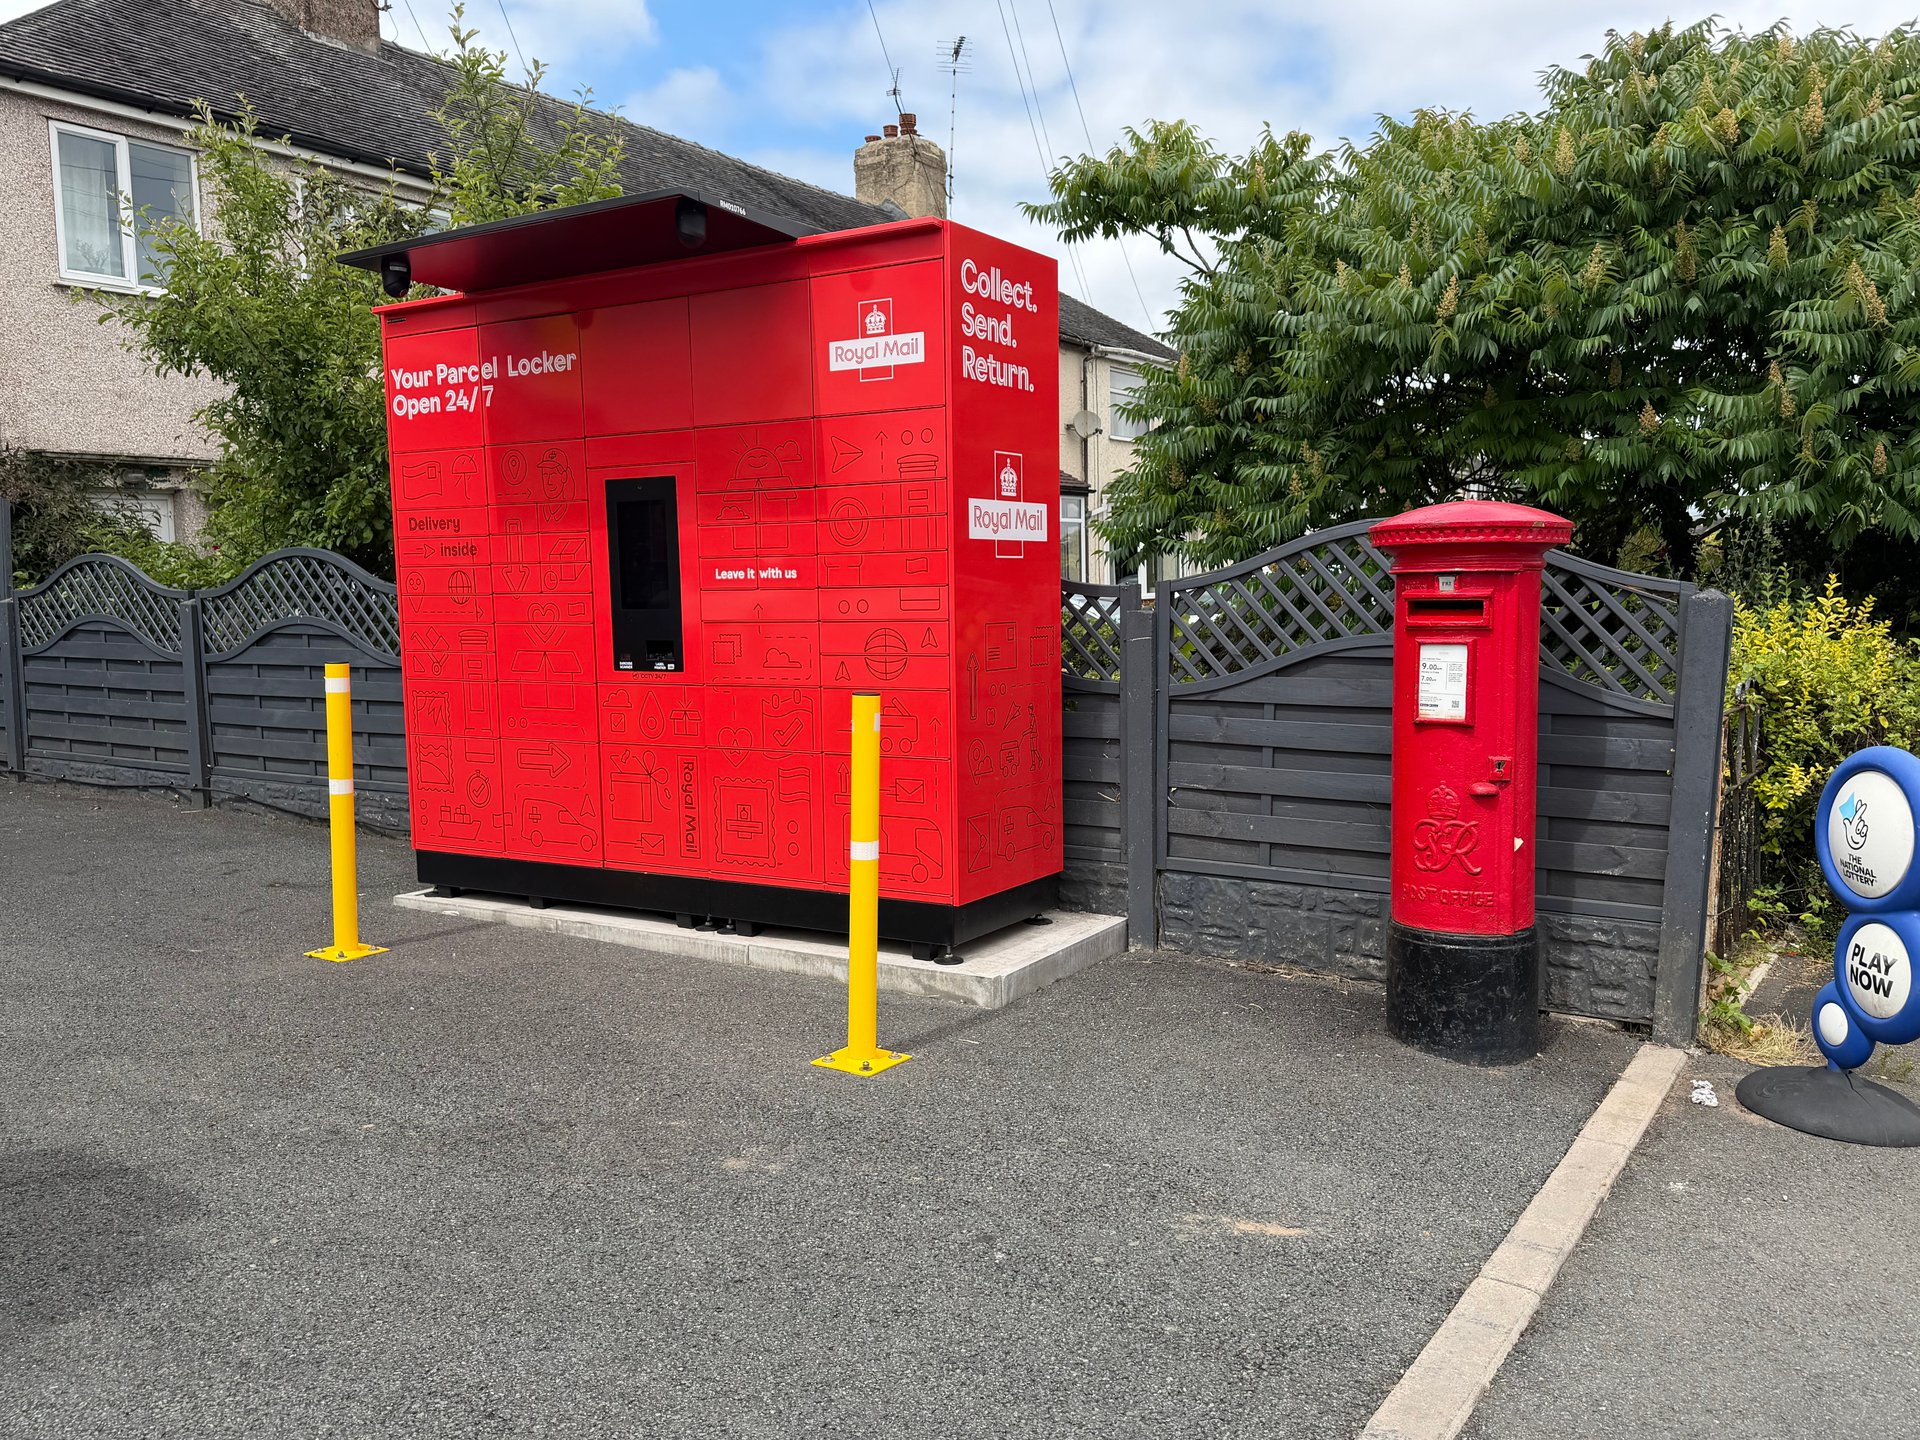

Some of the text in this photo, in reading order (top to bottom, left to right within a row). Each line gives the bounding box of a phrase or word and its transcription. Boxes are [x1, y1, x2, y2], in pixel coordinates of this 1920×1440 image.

[961, 258, 1038, 313] Collect.
[961, 302, 1017, 348] Send.
[834, 337, 919, 364] Royal Mail
[391, 350, 577, 390] Your Parcel Locker
[962, 345, 1035, 393] Return.
[393, 385, 494, 421] Open 24/7
[408, 516, 461, 533] Delivery
[973, 504, 1044, 535] Royal Mail
[440, 541, 478, 557] inside
[715, 567, 797, 580] Leave it with us
[682, 761, 698, 854] Royal Mail
[1840, 858, 1877, 879] NATIONAL
[1848, 853, 1862, 866] THE
[1842, 868, 1875, 887] LOTTERY
[1441, 889, 1494, 907] OFFICE
[1851, 943, 1898, 977] PLAY
[1850, 964, 1894, 998] NOW
